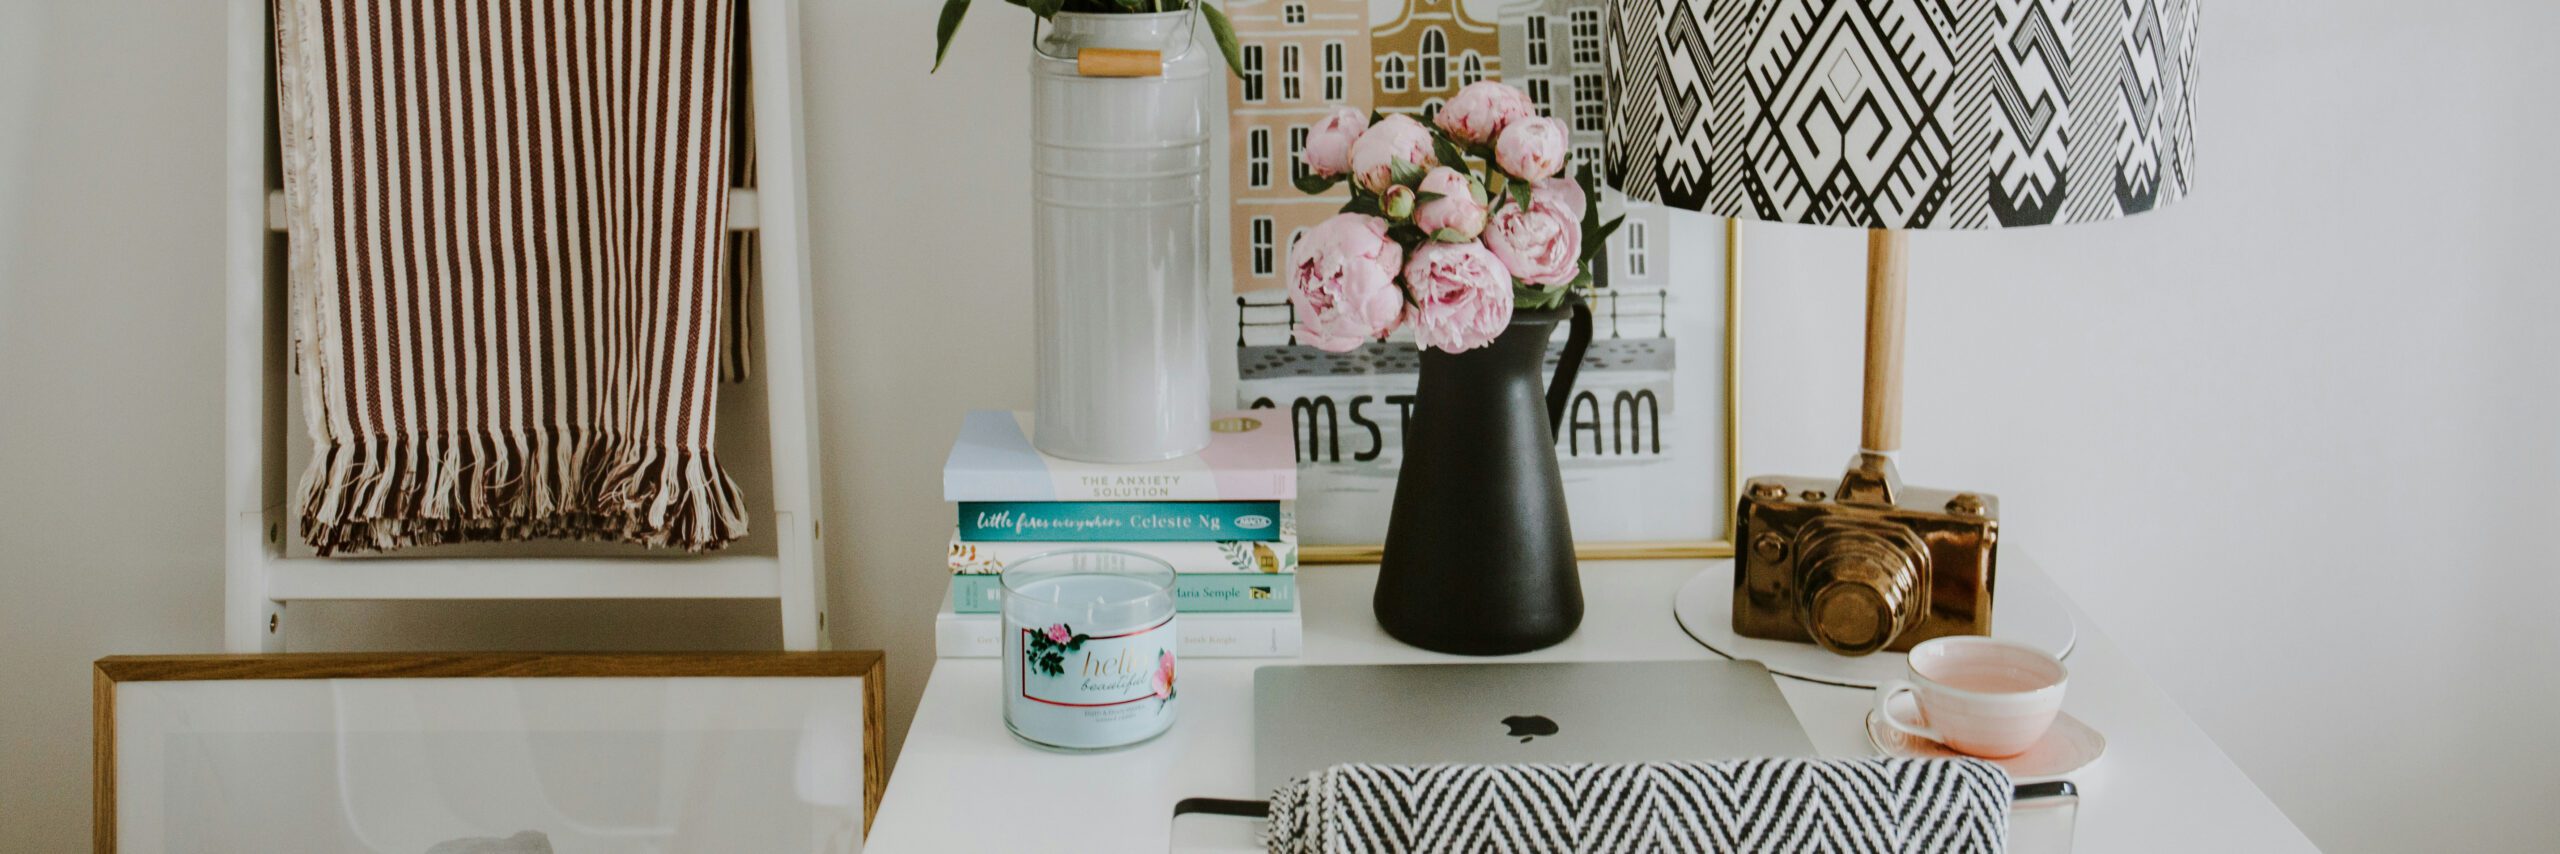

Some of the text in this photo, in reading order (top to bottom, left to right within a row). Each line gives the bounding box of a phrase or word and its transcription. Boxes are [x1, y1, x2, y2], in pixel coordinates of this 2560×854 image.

[1081, 475, 1181, 486] THE ANXIETY
[1092, 487, 1169, 497] SOLUTION
[1130, 514, 1220, 531] Celeste Ng
[1203, 586, 1241, 600] Semple
